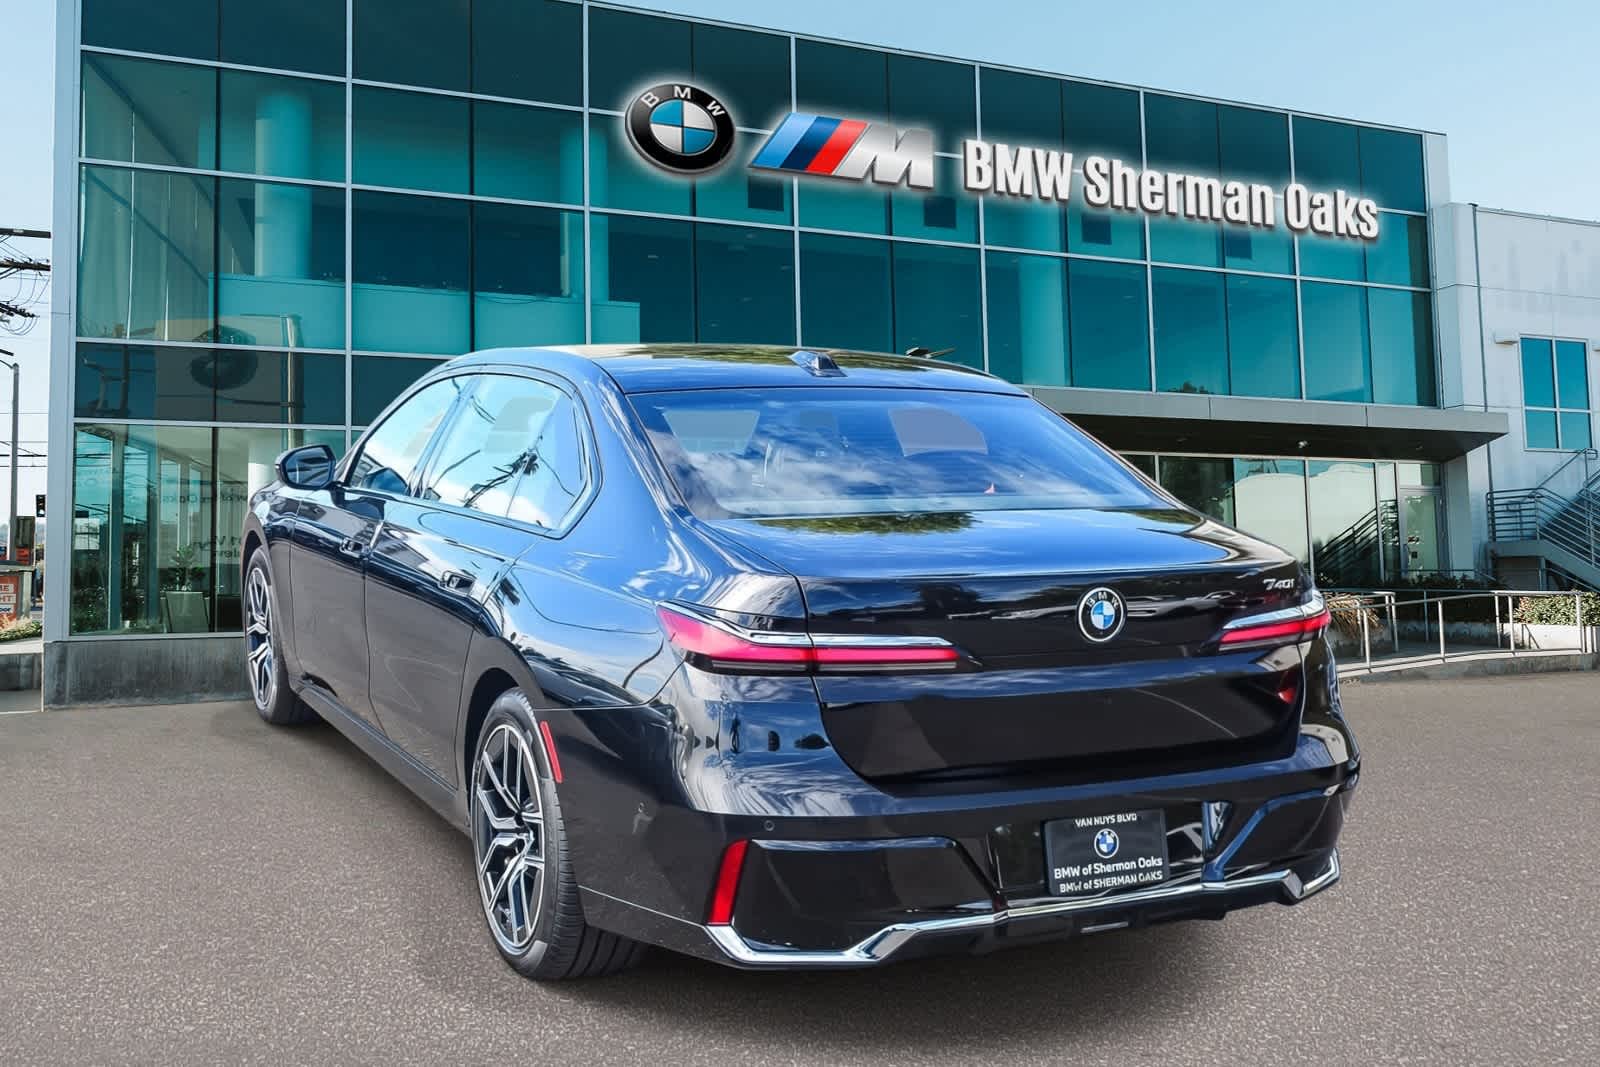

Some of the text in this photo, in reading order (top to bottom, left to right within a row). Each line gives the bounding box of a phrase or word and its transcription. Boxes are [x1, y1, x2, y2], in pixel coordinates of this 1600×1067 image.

[641, 85, 725, 117] BMW
[963, 139, 1380, 240] BMW Sherman Oaks
[1086, 591, 1119, 609] BMW
[1075, 813, 1137, 828] VAN NUYS BLVD
[1054, 856, 1163, 879] BMW of Sherman Oaks
[1060, 870, 1163, 893] BMW of SHERMAN OAKS
